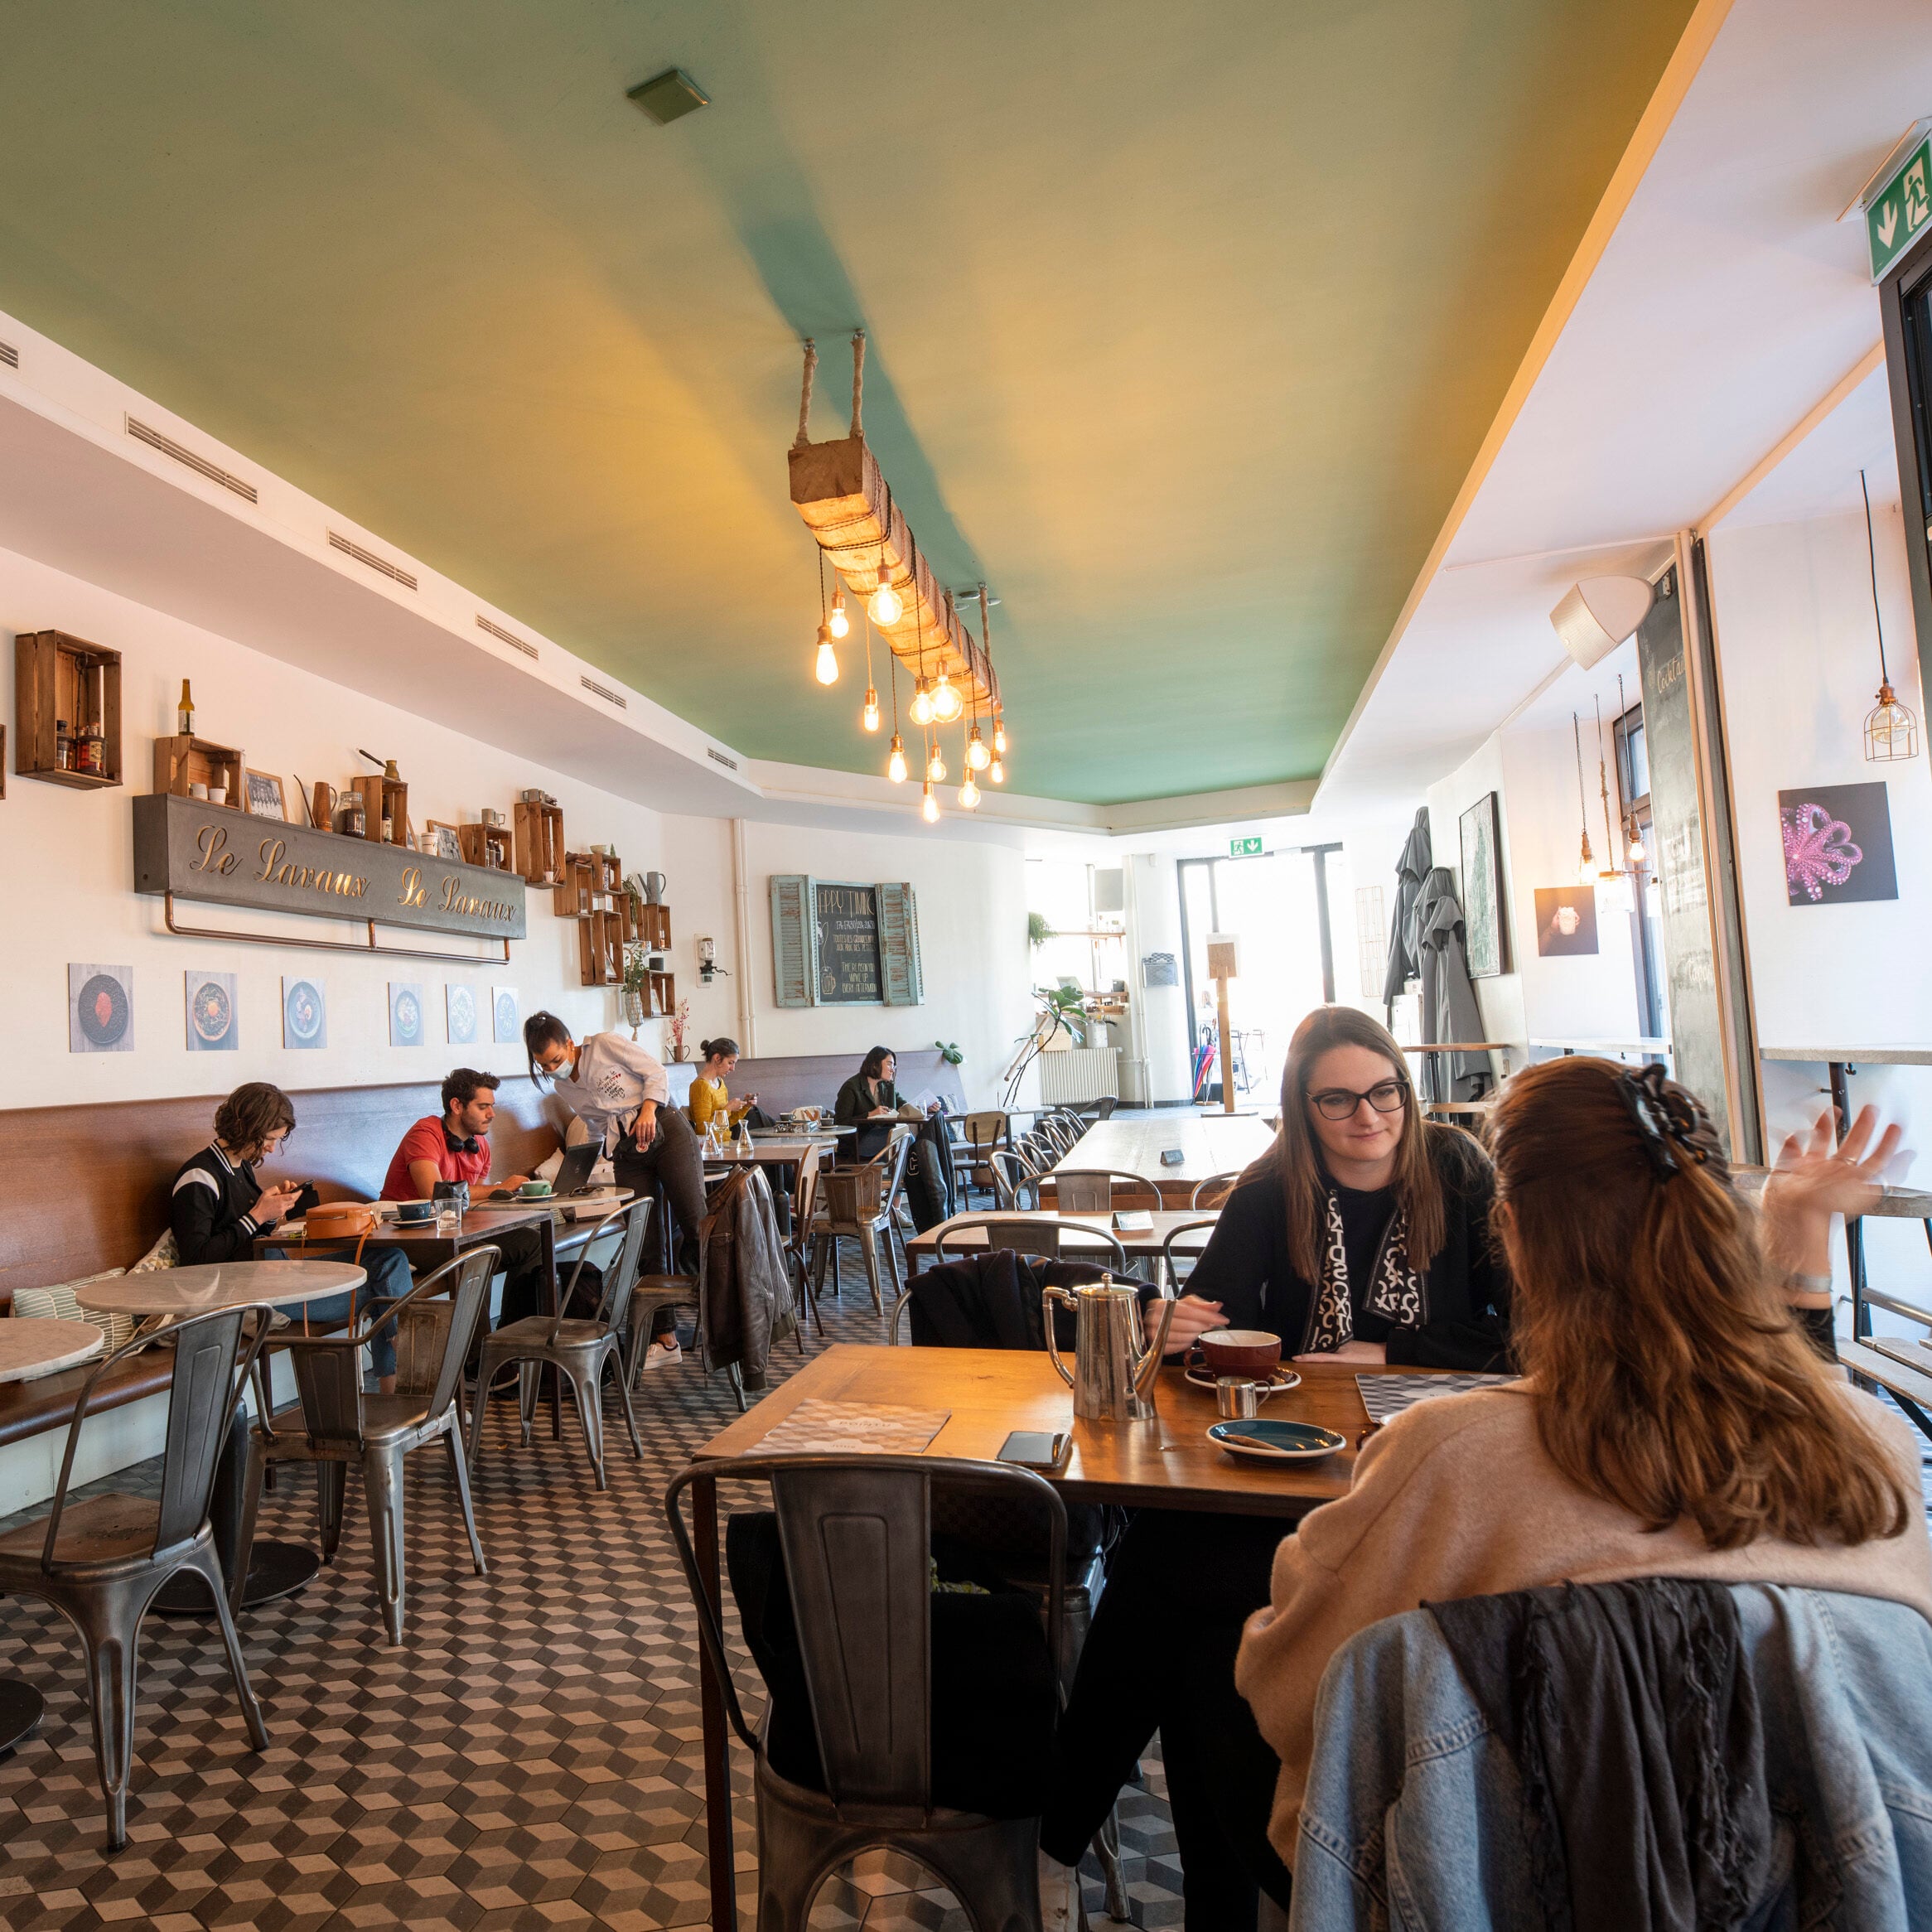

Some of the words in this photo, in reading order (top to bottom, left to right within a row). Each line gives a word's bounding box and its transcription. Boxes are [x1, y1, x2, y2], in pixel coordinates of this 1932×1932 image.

[189, 825, 244, 877] Le
[253, 838, 371, 898] Lavaux
[397, 867, 432, 909] Le
[437, 875, 518, 923] Lavaux
[862, 973, 868, 983] UP
